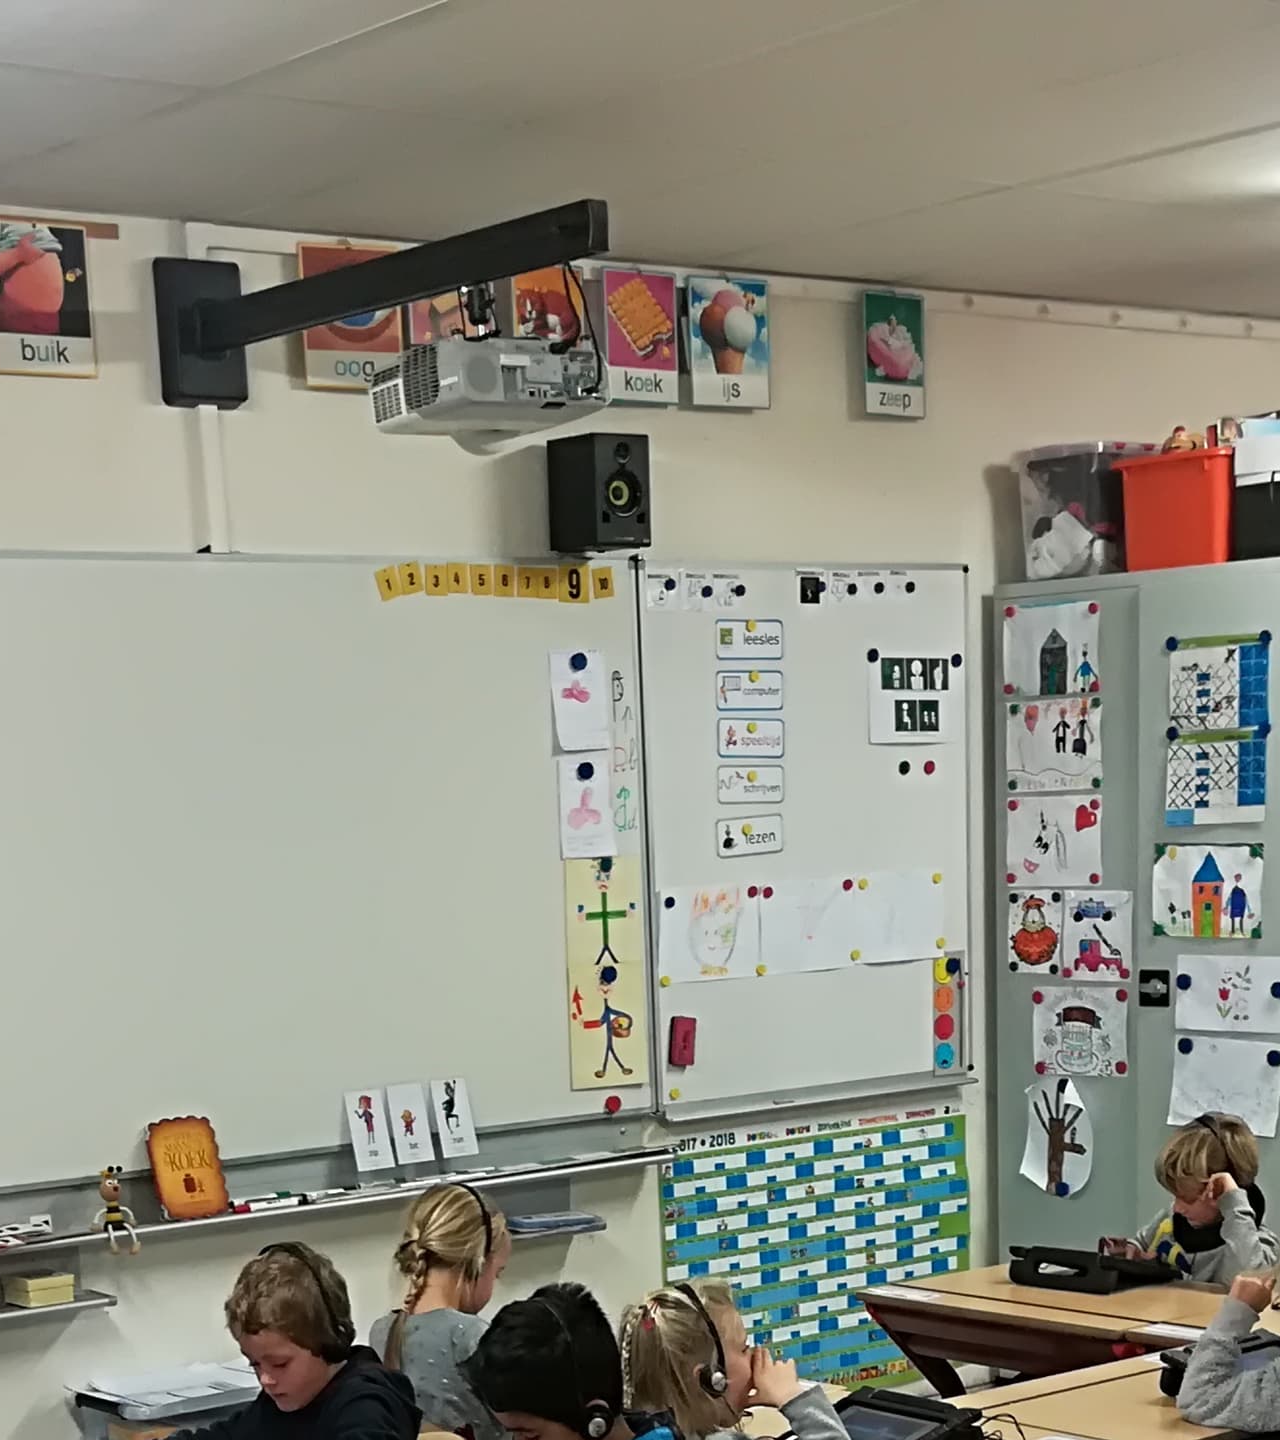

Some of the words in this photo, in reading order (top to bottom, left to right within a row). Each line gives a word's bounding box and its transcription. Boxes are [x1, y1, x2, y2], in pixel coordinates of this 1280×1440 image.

[20, 339, 70, 365] buik
[335, 360, 375, 383] oog
[624, 370, 664, 394] koek
[722, 382, 741, 403] ijs
[878, 388, 912, 412] zeep
[385, 578, 393, 592] 1
[407, 573, 416, 587] 2
[432, 574, 440, 588] 3
[453, 572, 461, 586] 4
[478, 573, 486, 587] 5
[501, 573, 509, 588] 6
[524, 576, 531, 589] 7
[567, 568, 582, 600] 9
[743, 632, 780, 646] leesles
[742, 686, 781, 697] computer
[745, 830, 776, 845] lezen
[672, 1138, 697, 1153] 017
[709, 1132, 736, 1147] 2018
